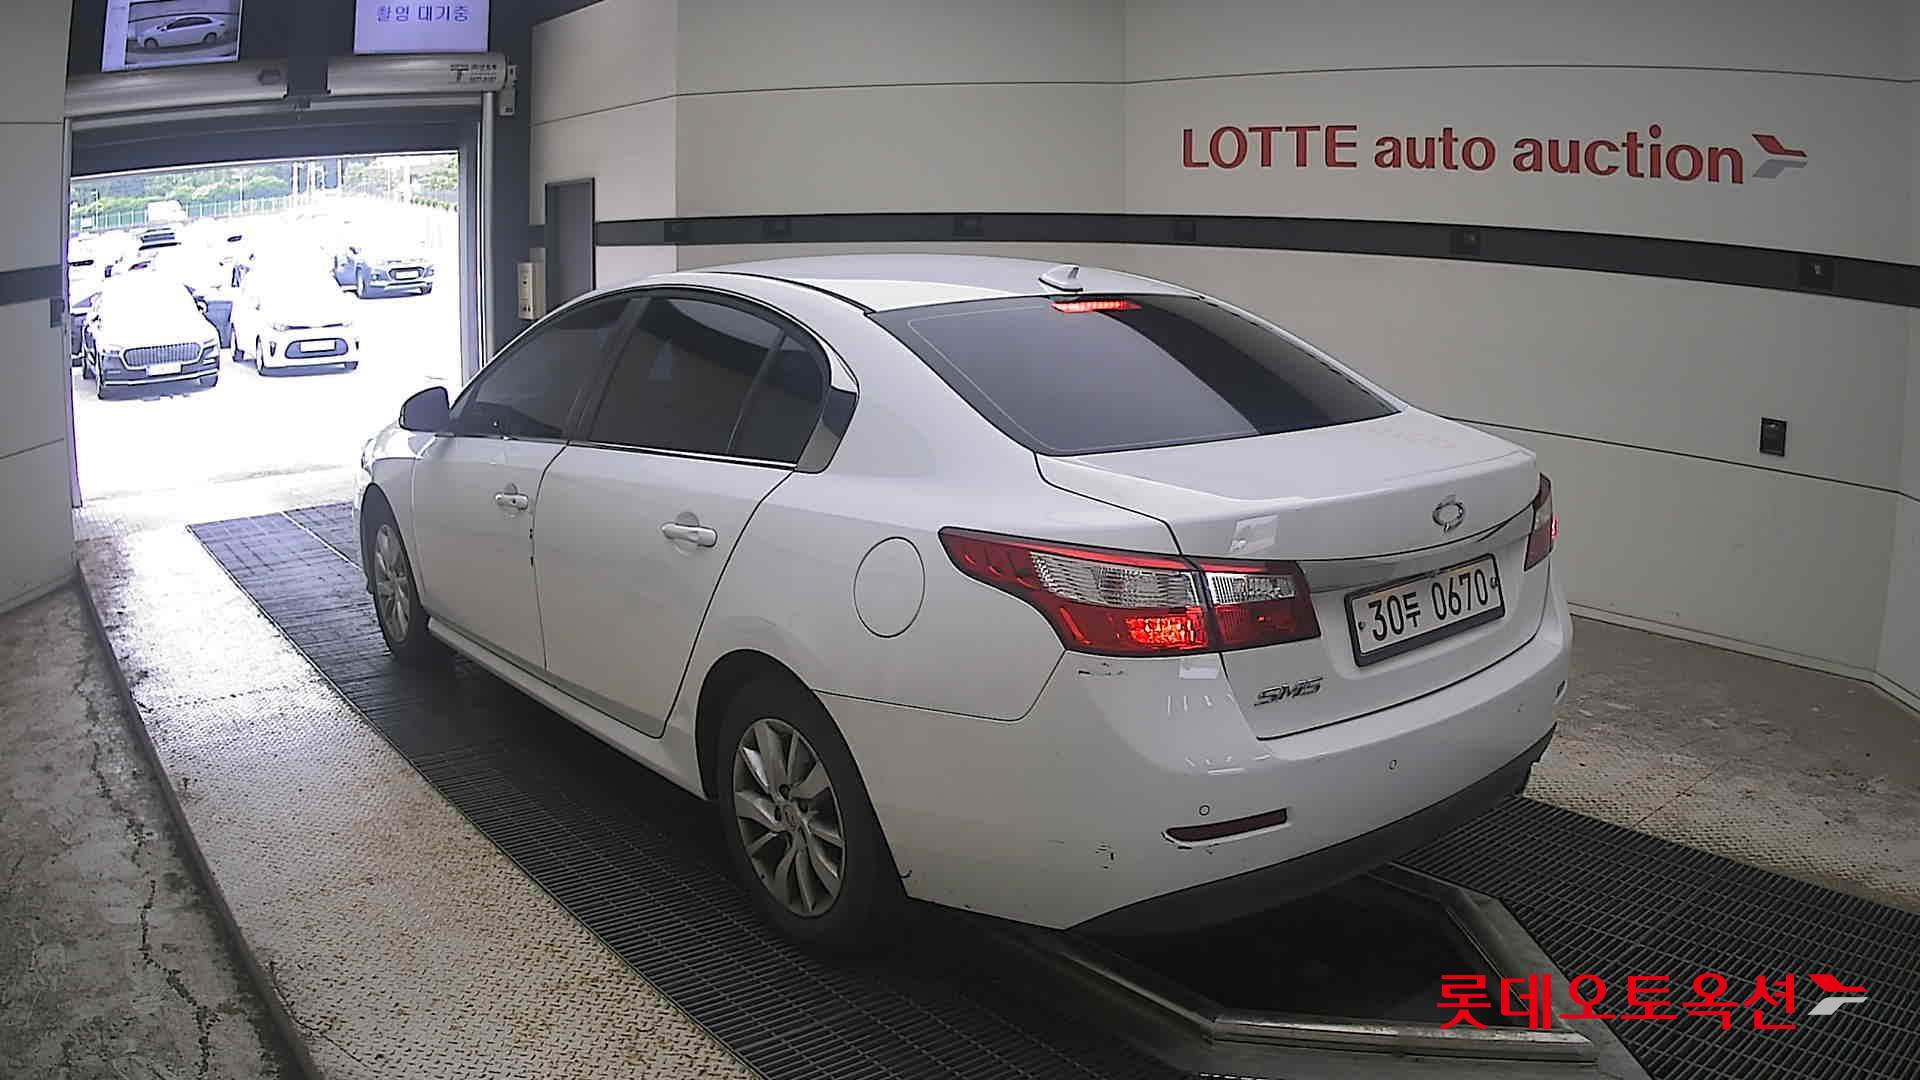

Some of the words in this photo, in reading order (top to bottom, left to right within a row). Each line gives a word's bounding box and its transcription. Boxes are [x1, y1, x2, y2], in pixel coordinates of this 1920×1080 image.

[418, 5, 468, 22] 대기중
[1182, 125, 1358, 169] LOTTE
[1373, 127, 1497, 171] auto
[1512, 124, 1745, 185] auction
[1367, 591, 1421, 641] 30두
[1431, 568, 1488, 620] 0670
[1254, 678, 1323, 707] SM5
